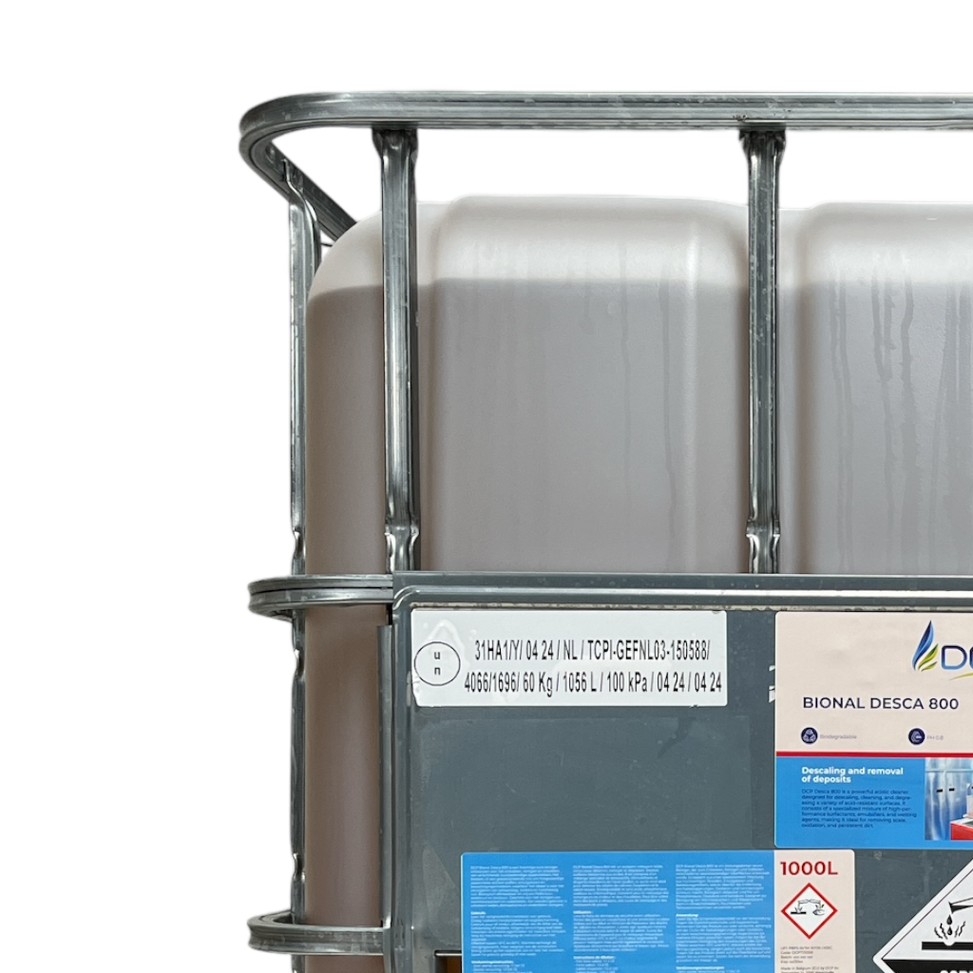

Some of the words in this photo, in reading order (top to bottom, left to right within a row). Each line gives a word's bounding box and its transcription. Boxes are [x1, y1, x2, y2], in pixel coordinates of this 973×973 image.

[475, 639, 523, 661] 31HA1/Y/
[526, 639, 539, 661] 04
[541, 639, 554, 661] 24
[563, 639, 578, 661] NL
[434, 652, 440, 660] u
[434, 667, 440, 675] n
[464, 672, 520, 692] 4066/1696/
[523, 672, 535, 692] 60
[539, 672, 553, 697] Kg
[563, 672, 587, 692] 1056
[591, 672, 597, 692] L
[607, 672, 624, 692] 100
[628, 672, 648, 692] kPa
[657, 672, 669, 692] 04
[672, 672, 685, 692] 24
[694, 672, 707, 692] 04
[710, 672, 722, 692] 24
[803, 697, 865, 708] BIONAL
[870, 698, 924, 709] DESCA
[929, 698, 959, 710] 800
[802, 767, 846, 776] Descaling
[848, 767, 865, 775] and
[867, 767, 903, 775] removal
[802, 775, 811, 783] of
[813, 775, 851, 784] deposits
[780, 861, 838, 875] 1000L
